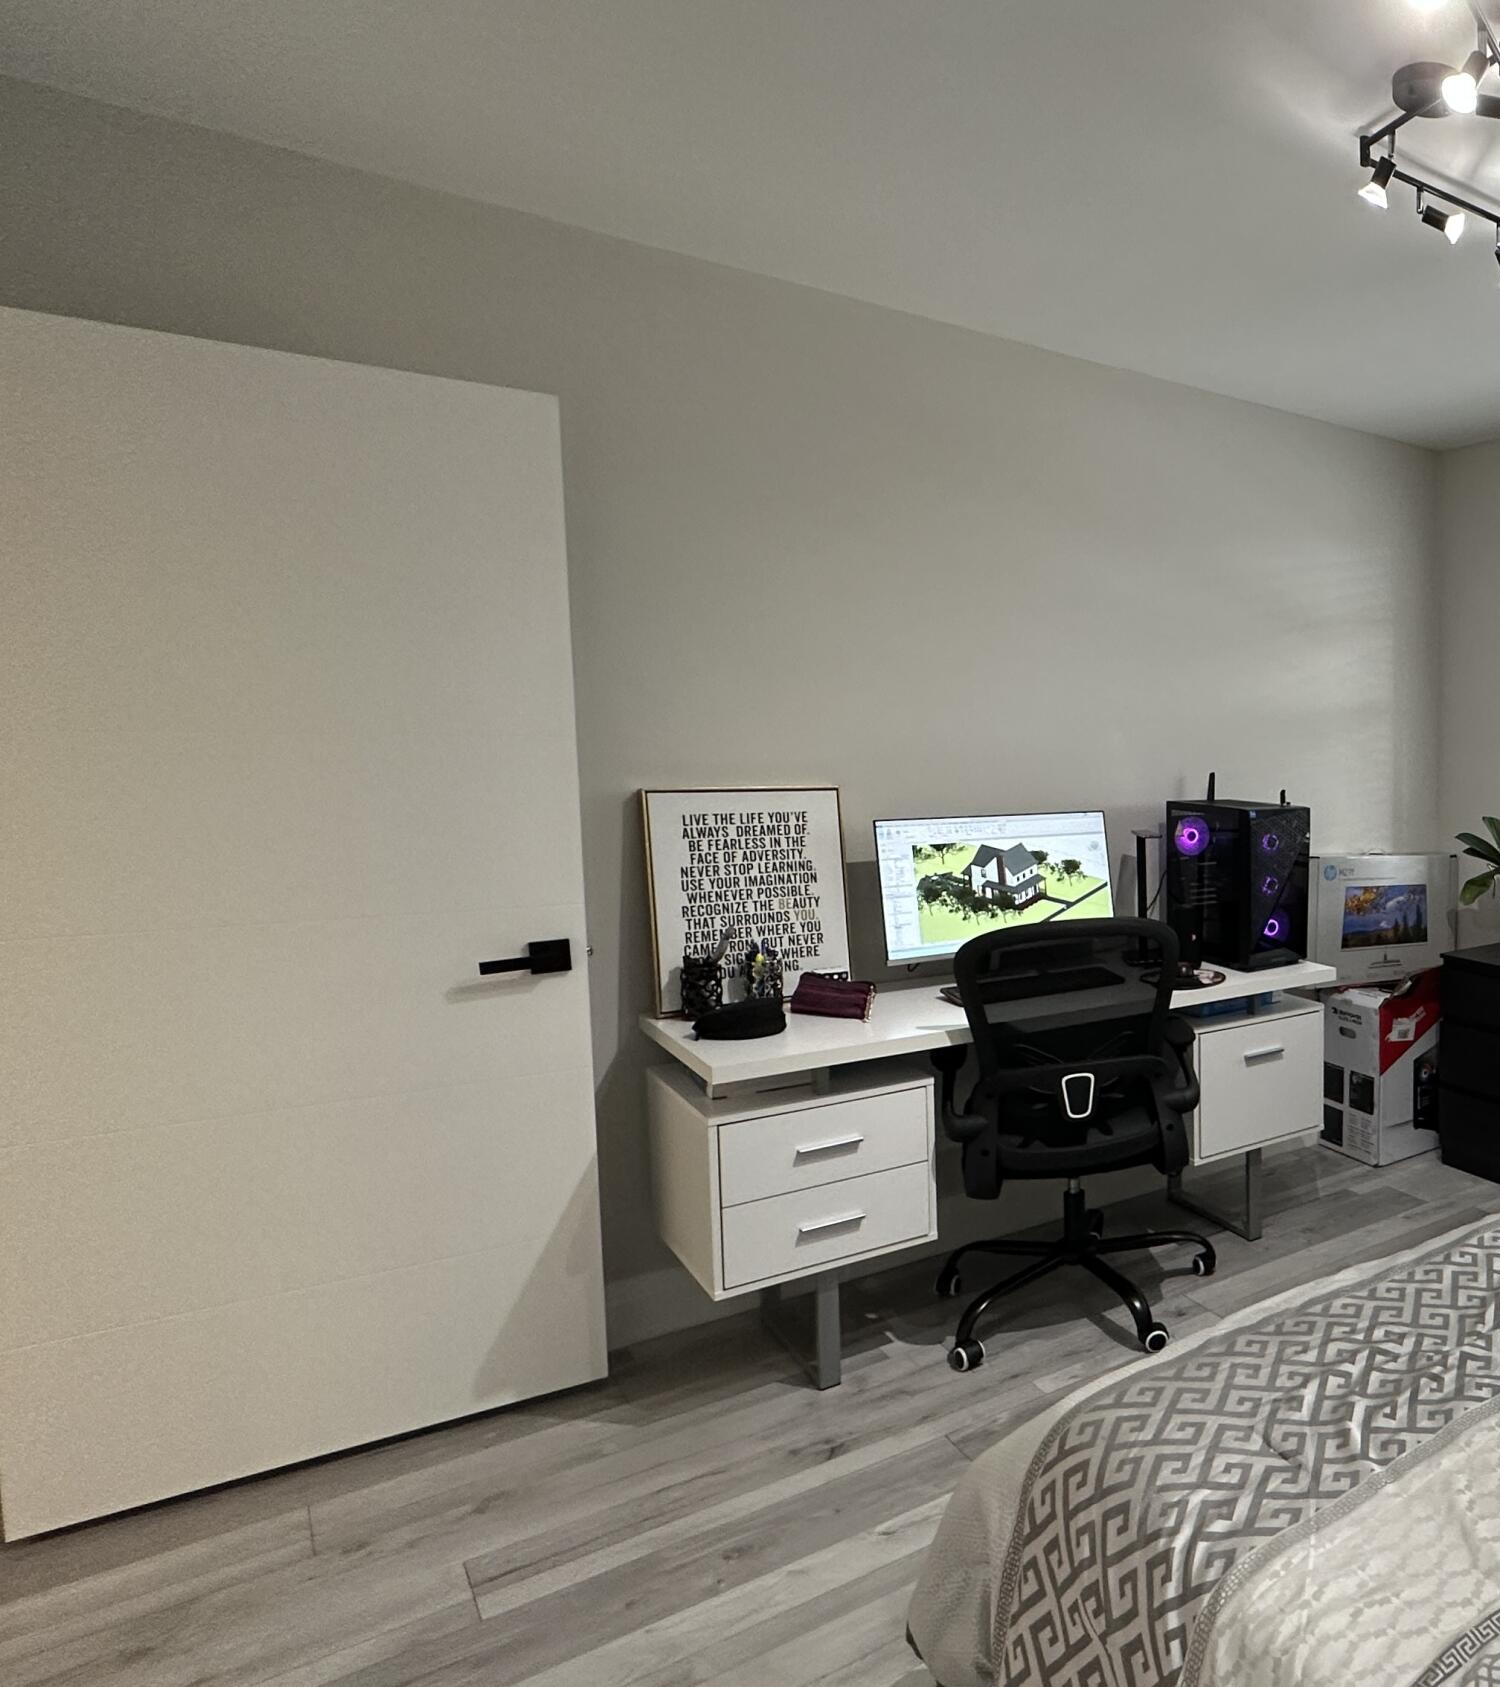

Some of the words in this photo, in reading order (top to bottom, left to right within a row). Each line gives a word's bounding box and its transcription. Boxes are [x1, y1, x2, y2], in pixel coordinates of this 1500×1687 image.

[682, 813, 709, 826] LIVE
[712, 812, 736, 825] THE
[740, 812, 764, 824] LIFE
[768, 811, 808, 824] YOU'VE
[682, 826, 730, 840] ALWAYS
[736, 824, 791, 838] DREAMED
[794, 824, 811, 836] OF.
[688, 839, 704, 852] BE
[708, 836, 766, 851] FEARLESS
[770, 836, 781, 848] IN
[785, 836, 806, 848] THE
[690, 852, 720, 865] FACE
[723, 850, 738, 864] OF
[742, 848, 808, 863] ADVERSITY.
[680, 864, 720, 879] NEVER
[724, 863, 754, 876] STOP
[758, 860, 816, 874] LEARNING.
[681, 878, 704, 892] USE
[708, 876, 740, 890] YOUR
[744, 872, 818, 888] IMAGINATION
[686, 888, 753, 904] WHENEVER
[758, 884, 815, 900] POSSIBLE.
[682, 901, 749, 918] RECOGNIZE
[752, 900, 774, 912] THE
[778, 896, 821, 910] BEAUTY
[685, 916, 716, 930] THAT
[720, 911, 790, 928] SURROUNDS
[756, 922, 796, 938] WHERE
[800, 920, 822, 933] YOU
[684, 942, 717, 957] CAME
[788, 932, 824, 947] NEVER
[780, 945, 820, 960] WHERE
